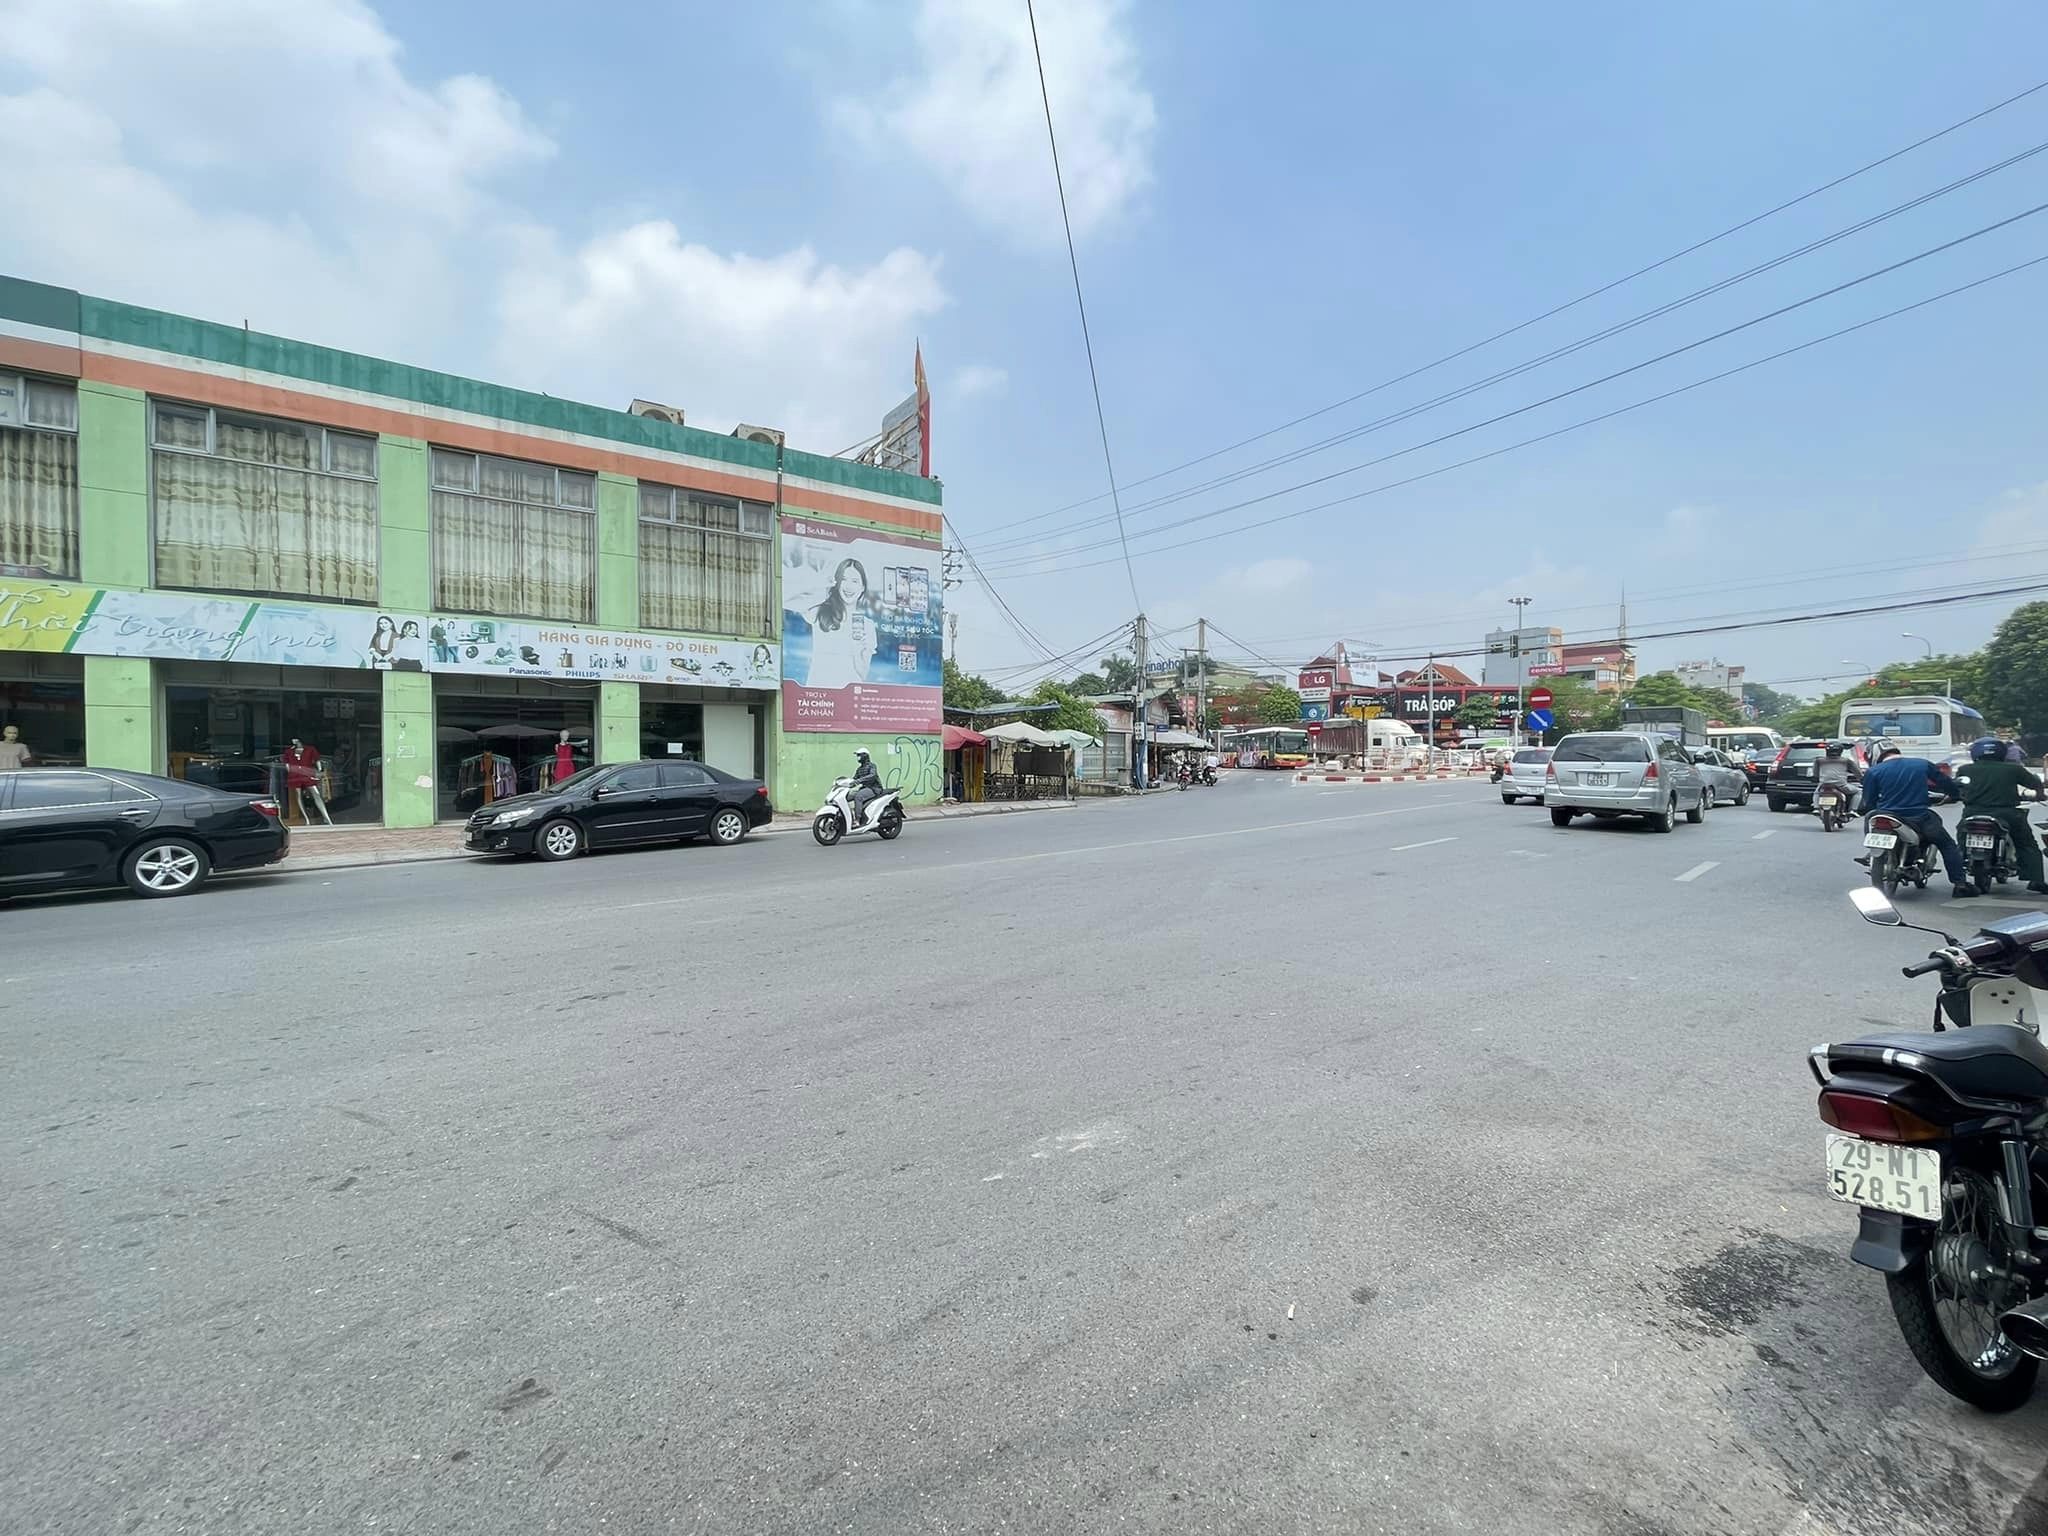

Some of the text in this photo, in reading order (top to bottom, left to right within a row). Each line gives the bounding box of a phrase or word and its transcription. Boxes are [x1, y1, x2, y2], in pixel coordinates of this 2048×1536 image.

[806, 526, 839, 538] SeABank
[585, 634, 609, 646] GIA
[615, 636, 652, 651] DỤNG
[509, 667, 552, 676] Panasonic
[565, 670, 600, 679] PHILIPS
[1314, 675, 1326, 684] LG
[811, 700, 834, 708] CHÍNH
[1405, 695, 1456, 712] TRẢ GÓP
[1842, 1141, 1918, 1180] 29-N1
[1834, 1168, 1930, 1213] 528.51
